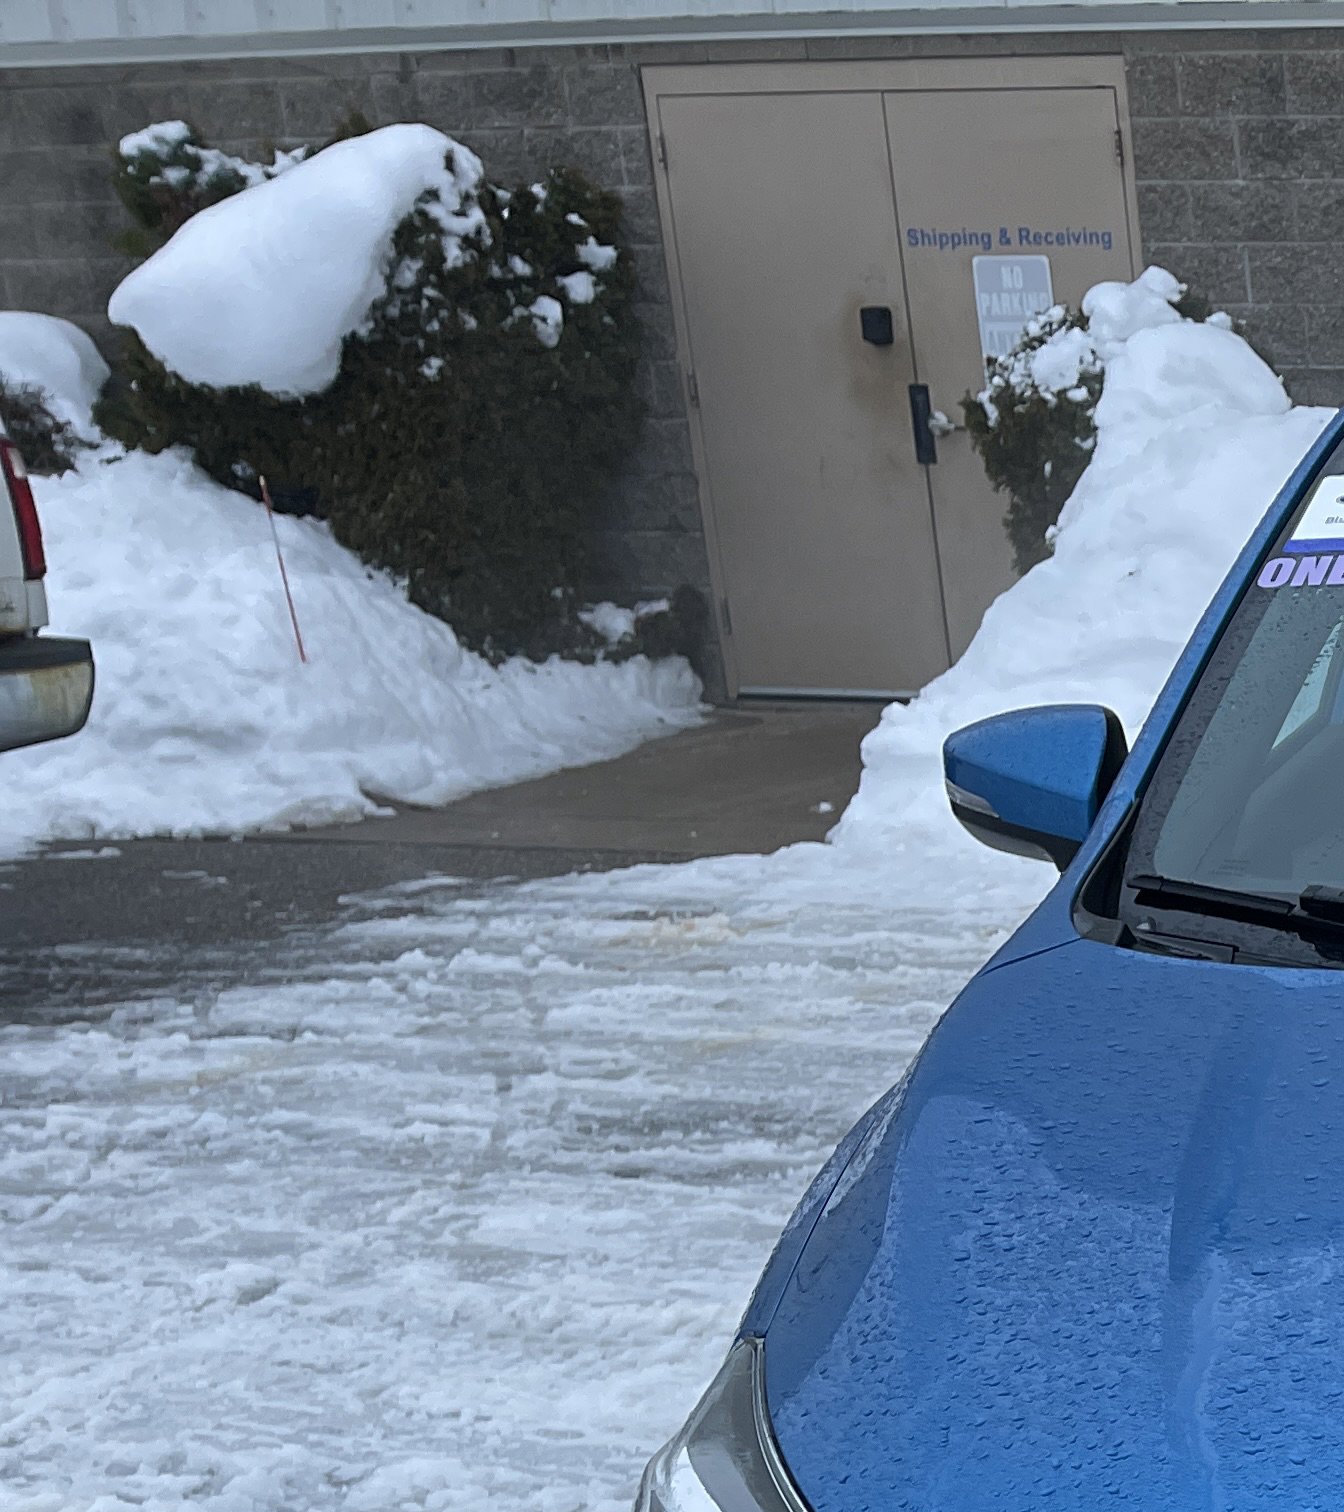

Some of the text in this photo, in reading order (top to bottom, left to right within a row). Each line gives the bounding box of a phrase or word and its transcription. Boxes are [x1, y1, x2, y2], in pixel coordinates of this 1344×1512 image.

[906, 227, 1112, 250] Shipping & Receiving
[1001, 265, 1023, 289] NO
